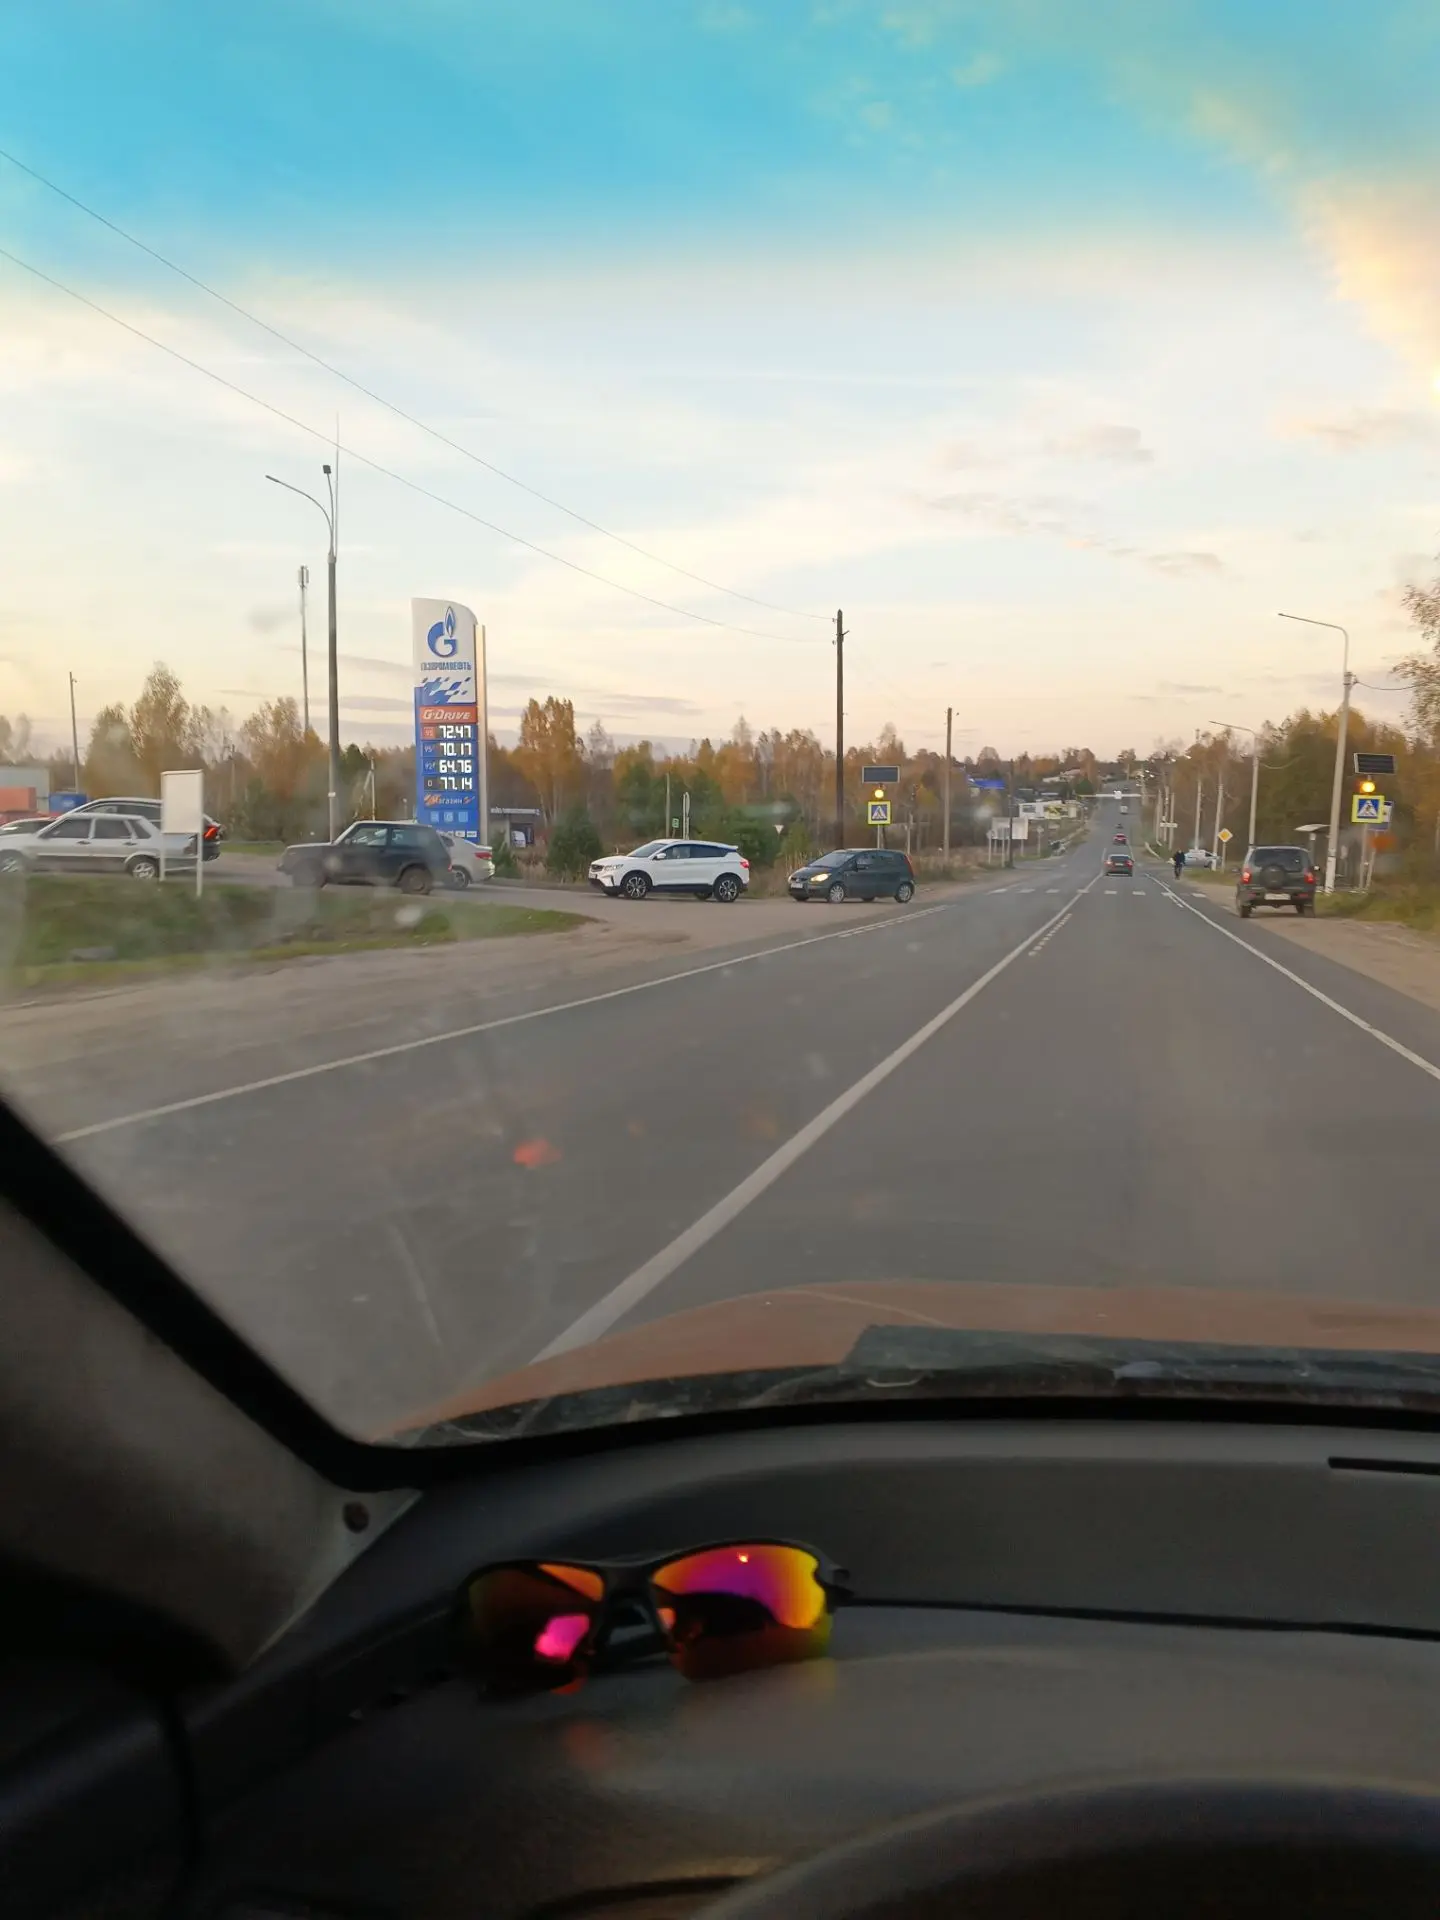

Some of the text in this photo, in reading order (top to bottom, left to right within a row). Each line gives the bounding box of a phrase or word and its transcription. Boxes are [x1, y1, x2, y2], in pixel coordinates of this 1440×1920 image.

[438, 725, 472, 739] 72.47
[439, 742, 472, 756] 70.17
[439, 759, 472, 773] 64.76
[440, 776, 472, 790] 77.14
